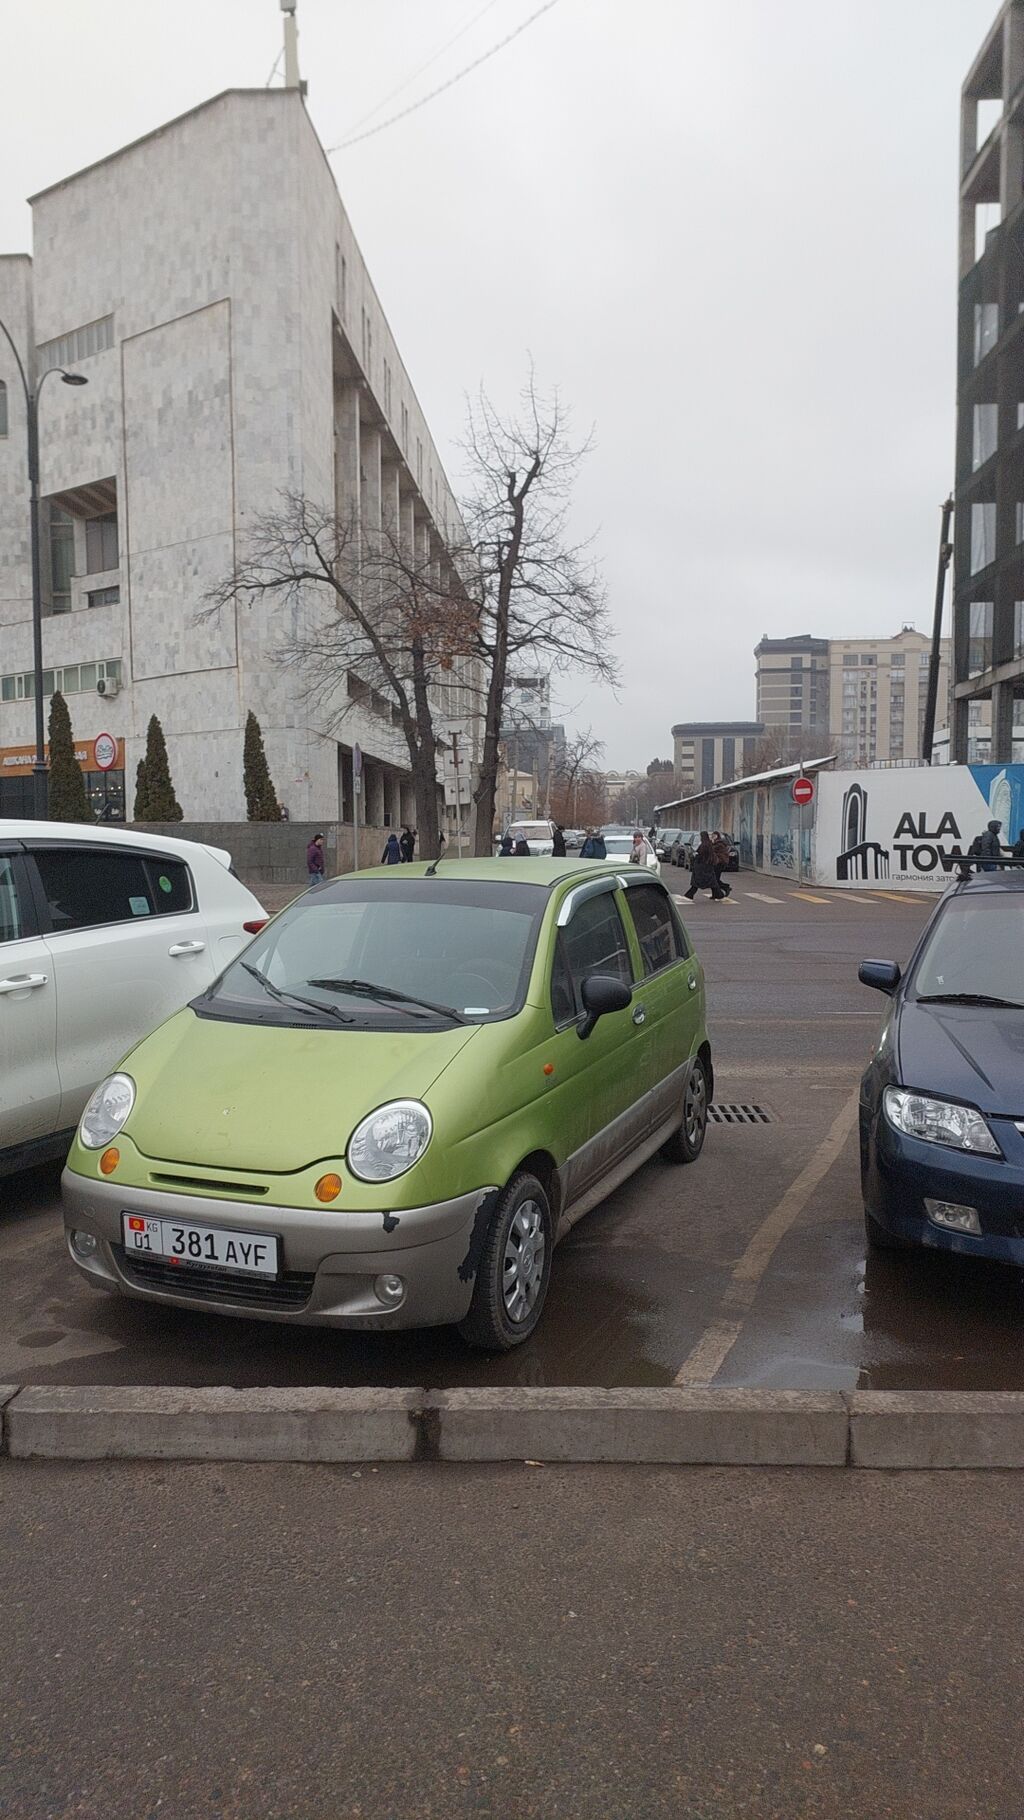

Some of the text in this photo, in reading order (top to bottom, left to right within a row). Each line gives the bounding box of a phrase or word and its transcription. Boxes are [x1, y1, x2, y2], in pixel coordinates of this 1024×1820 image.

[893, 812, 962, 839] ALA
[893, 844, 974, 872] TOW
[892, 874, 934, 882] гармония
[146, 1222, 158, 1233] KG
[134, 1231, 152, 1251] 01
[171, 1228, 219, 1261] 381
[225, 1240, 267, 1266] AYF
